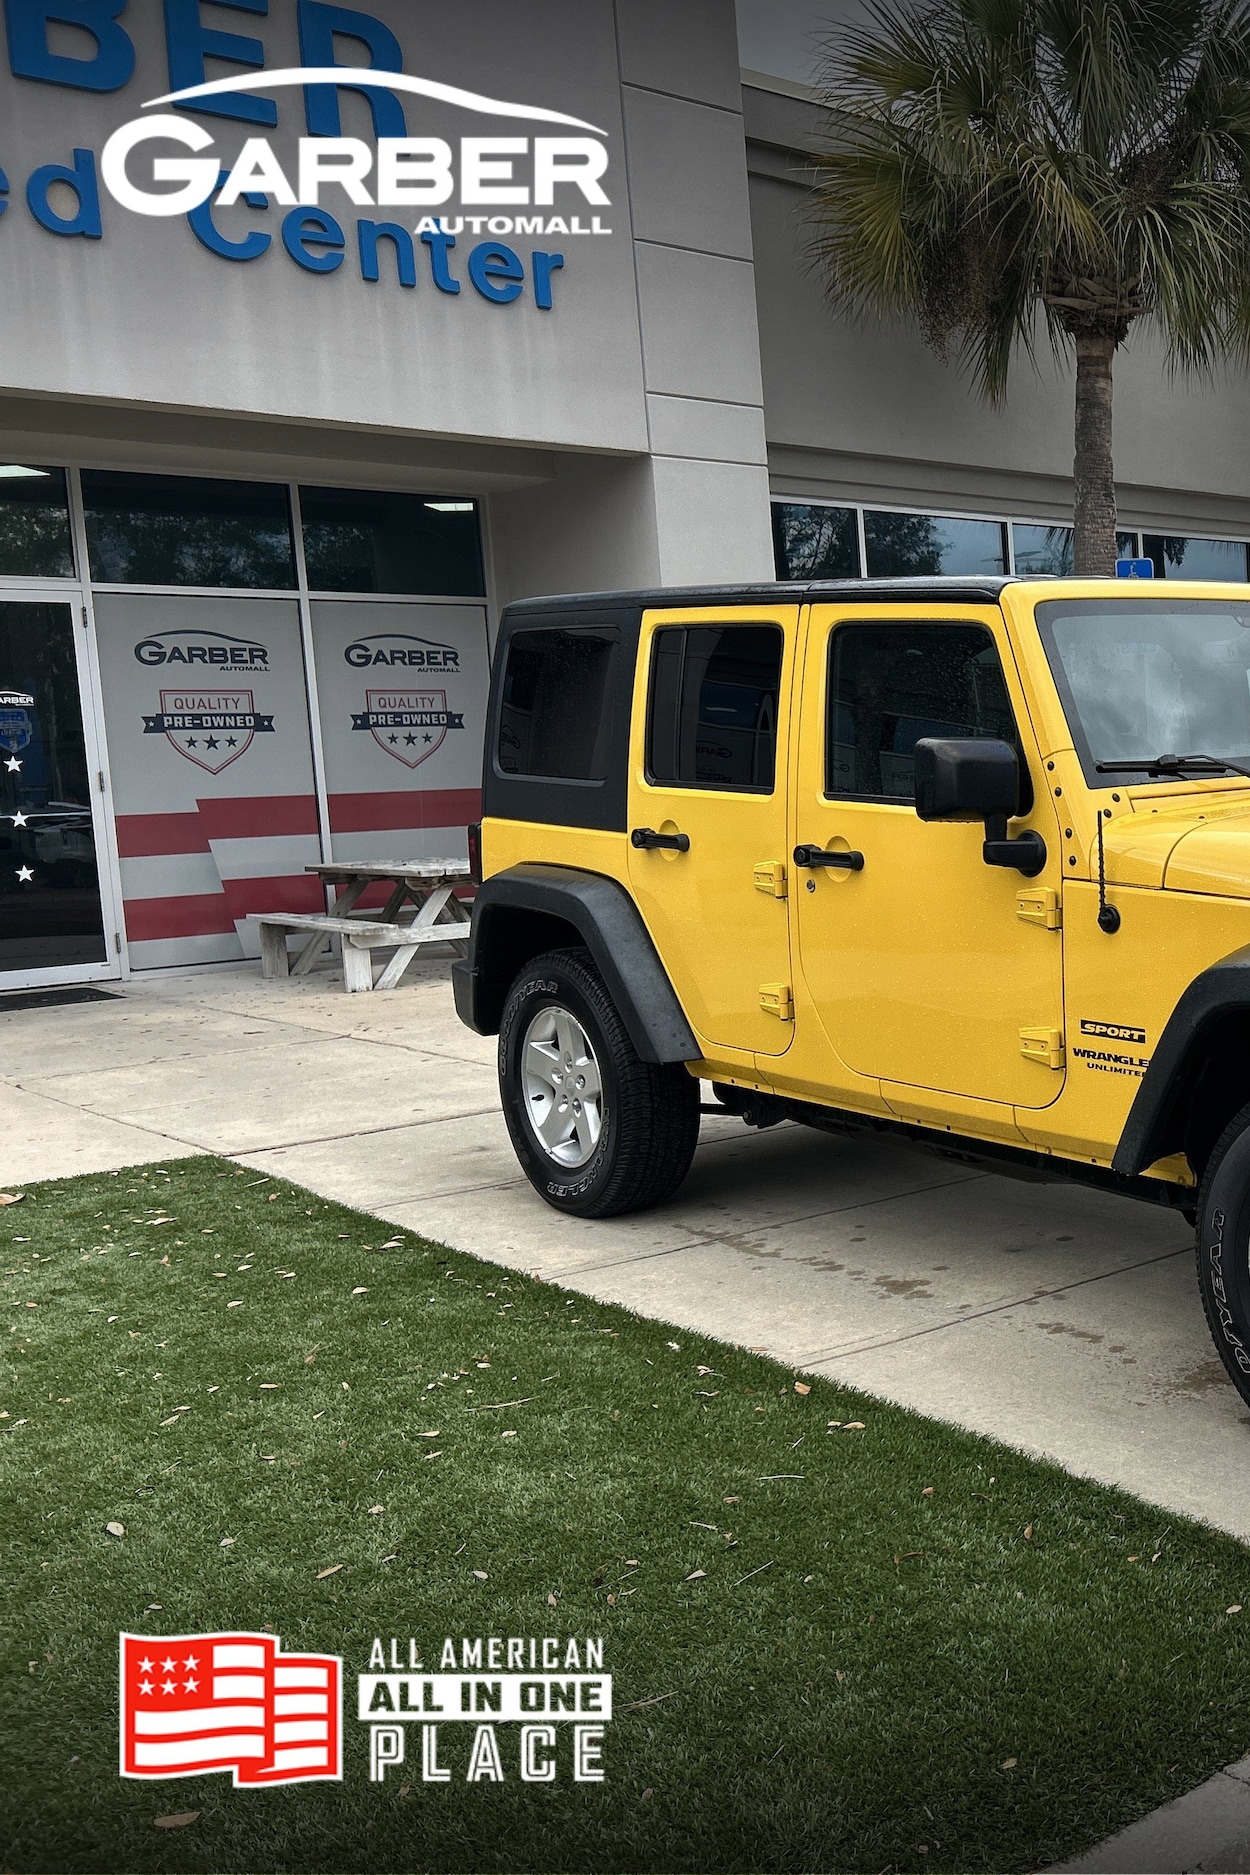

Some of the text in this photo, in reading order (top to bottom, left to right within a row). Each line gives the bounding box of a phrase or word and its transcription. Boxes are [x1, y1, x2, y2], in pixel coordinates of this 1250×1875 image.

[0, 147, 564, 311] d Center
[134, 640, 269, 666] GARBER
[344, 643, 460, 668] GARBER
[174, 697, 240, 710] QUALITY
[378, 696, 435, 709] QUALITY
[163, 715, 255, 728] PRE-OWNED
[367, 713, 448, 725] PRE-OWNED
[1082, 1022, 1146, 1041] SPORT
[1072, 1047, 1151, 1069] WRANGLE
